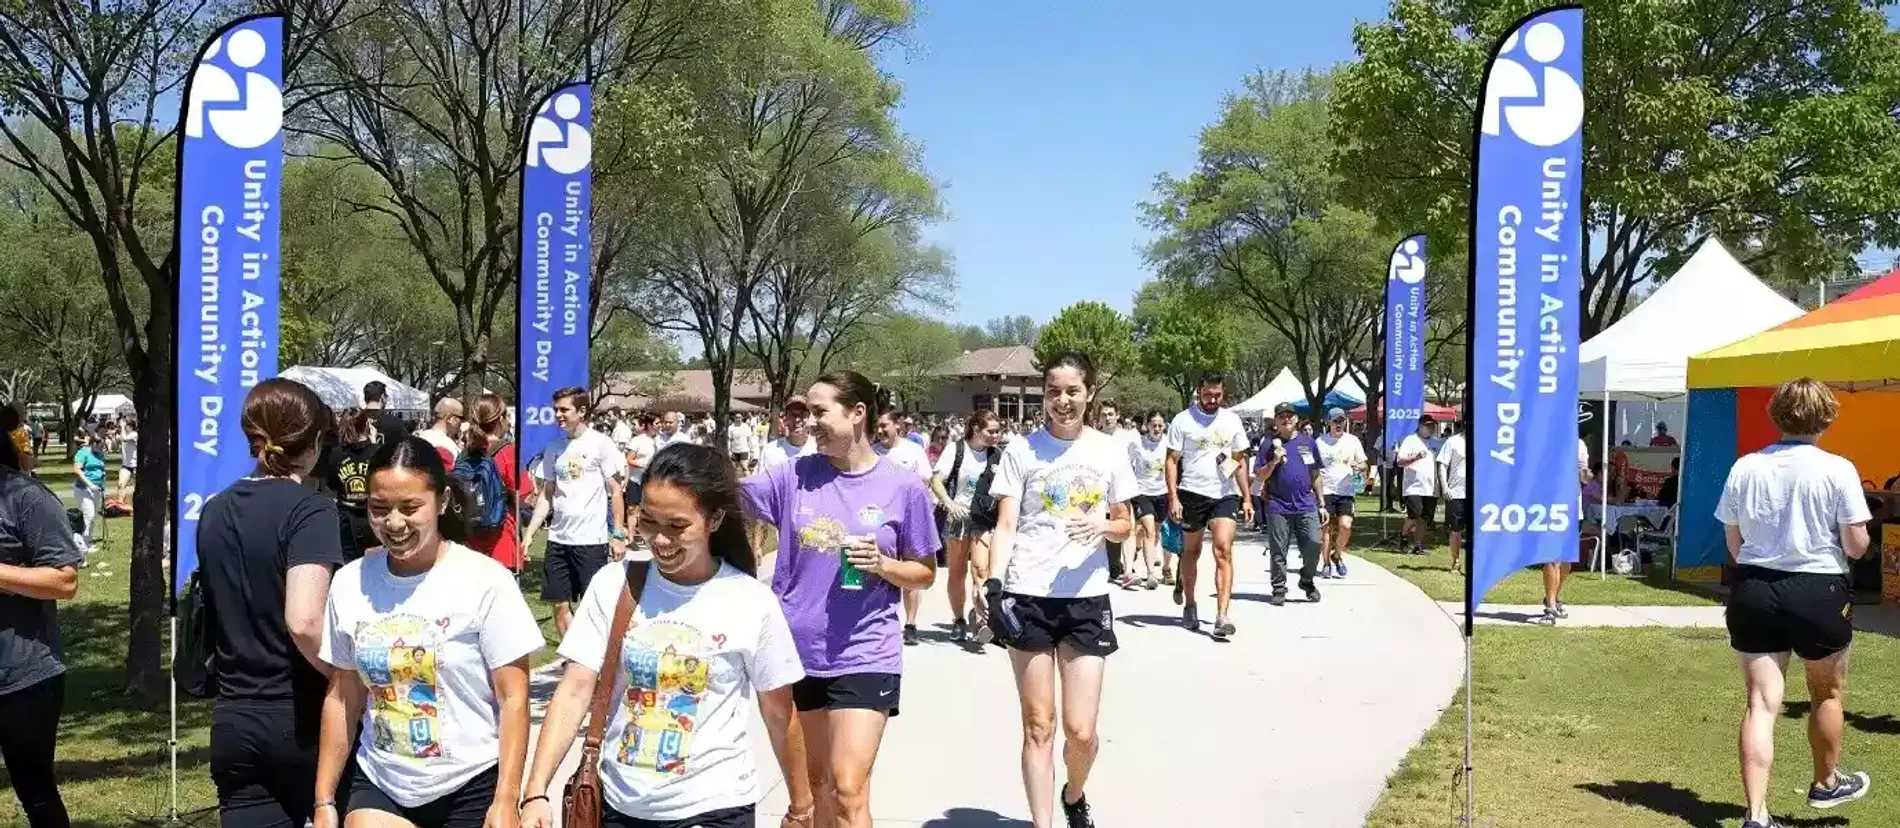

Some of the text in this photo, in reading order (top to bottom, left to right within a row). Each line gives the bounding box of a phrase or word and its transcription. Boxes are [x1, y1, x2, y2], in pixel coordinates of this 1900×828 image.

[194, 205, 227, 384] Community
[236, 160, 269, 387] Unity in Action
[532, 212, 555, 382] Community Day
[561, 181, 583, 335] Unity in Action
[1534, 157, 1568, 394] Unity in Action
[1392, 303, 1405, 396] Community Day
[1407, 286, 1420, 371] Unity in Action
[1490, 204, 1525, 465] Community Day
[193, 396, 223, 456] Day
[526, 405, 556, 425] 20
[1388, 408, 1421, 420] 2025
[1479, 503, 1570, 533] 2025
